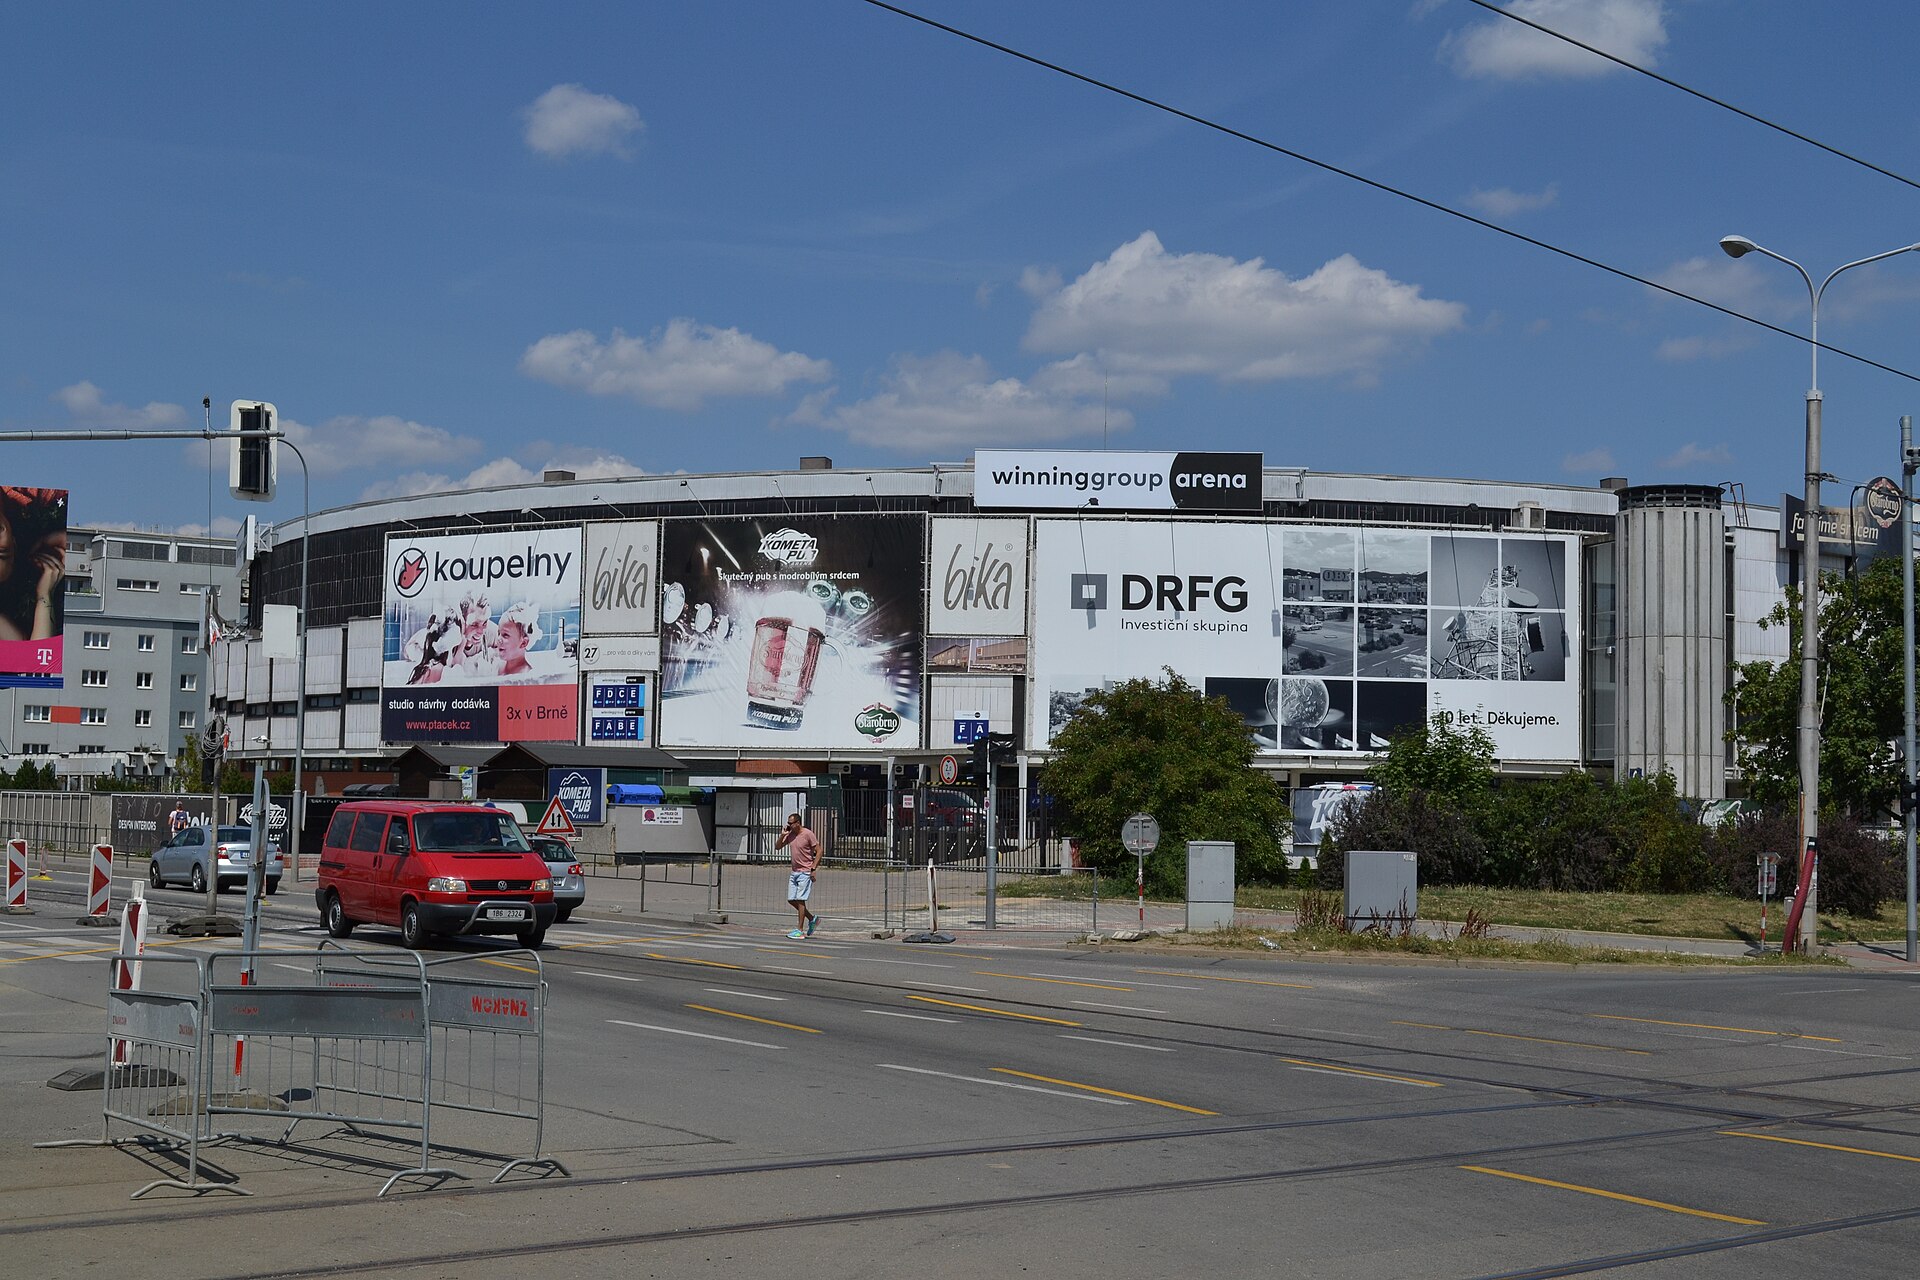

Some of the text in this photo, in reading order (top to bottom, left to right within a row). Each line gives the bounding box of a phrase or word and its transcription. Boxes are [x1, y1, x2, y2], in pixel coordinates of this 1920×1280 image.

[991, 464, 1247, 491] winninggroup arena
[1790, 512, 1836, 534] faíme
[762, 539, 816, 550] KOMETA
[434, 546, 572, 587] koupelny
[718, 571, 754, 583] Skutečný
[756, 571, 771, 582] pub
[779, 571, 828, 582] modrobílým
[829, 571, 860, 580] srdcem
[943, 543, 1013, 611] bika
[1121, 573, 1249, 613] DRFG
[1121, 617, 1248, 635] Investiční skupina
[584, 647, 598, 659] 27
[596, 689, 636, 698] F D C E
[388, 697, 491, 712] studio návrhy dodávka
[506, 704, 568, 720] 3x v Brně
[751, 709, 799, 724] KOMETA PUB
[858, 714, 898, 733] Starobrno
[1487, 710, 1560, 730] Děkujeme.
[406, 719, 471, 732] www.ptacek.cz
[595, 722, 636, 731] F A B E
[959, 724, 984, 734] F A
[557, 786, 592, 799] KOMETA
[572, 799, 592, 813] PUB
[118, 819, 157, 831] DESIGN INTERIORS
